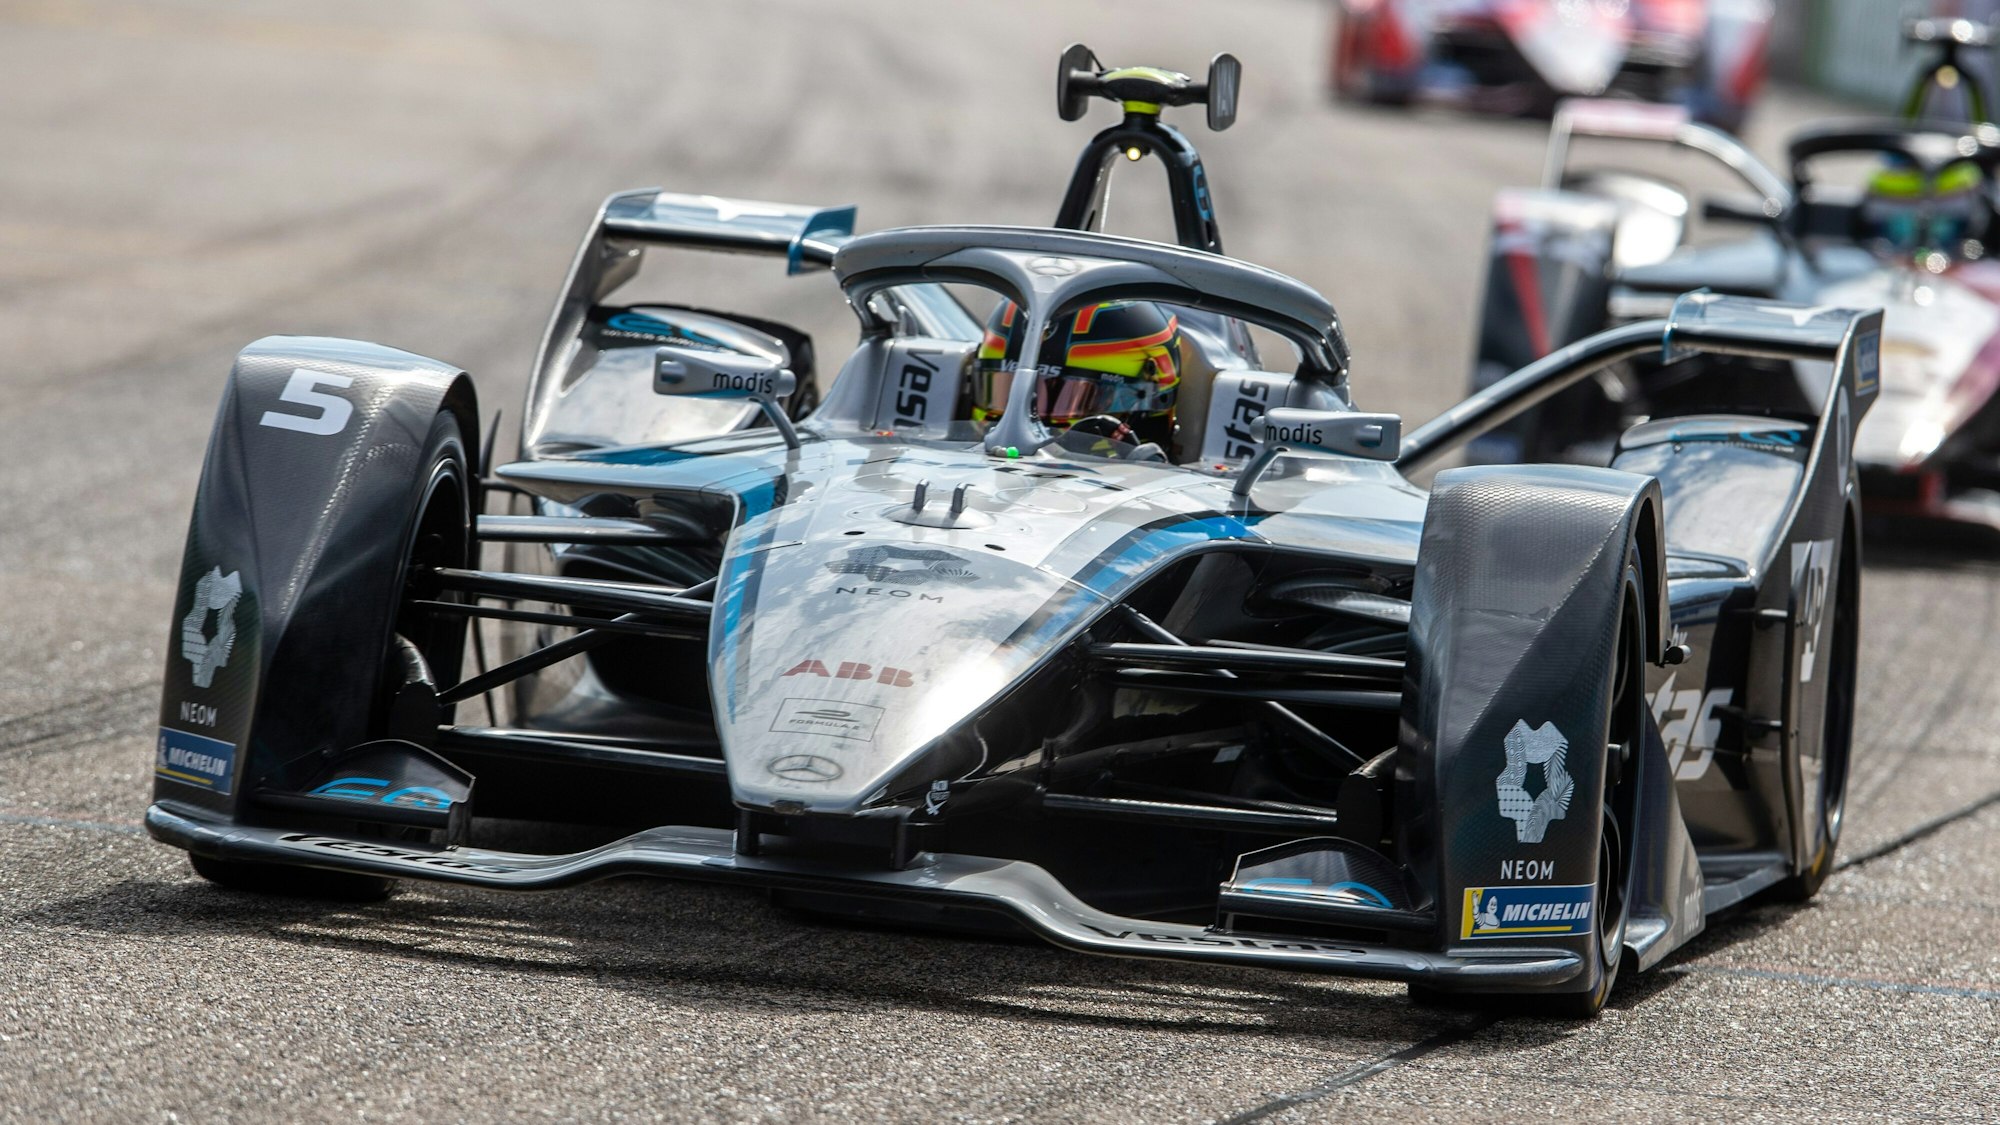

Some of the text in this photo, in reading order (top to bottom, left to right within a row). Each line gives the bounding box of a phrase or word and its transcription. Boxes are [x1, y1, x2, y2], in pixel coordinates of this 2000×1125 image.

[1000, 358, 1063, 378] Veas
[713, 370, 774, 395] modis
[259, 368, 354, 436] 5
[1264, 423, 1323, 445] modis
[836, 587, 944, 604] NEOM
[781, 659, 915, 688] ABB
[180, 701, 218, 728] NEOM
[789, 719, 850, 729] FORMULA
[1645, 671, 1734, 781] tas
[168, 746, 228, 777] MICHELIN
[1500, 860, 1555, 880] NEOM
[1502, 901, 1591, 922] MICHELIN
